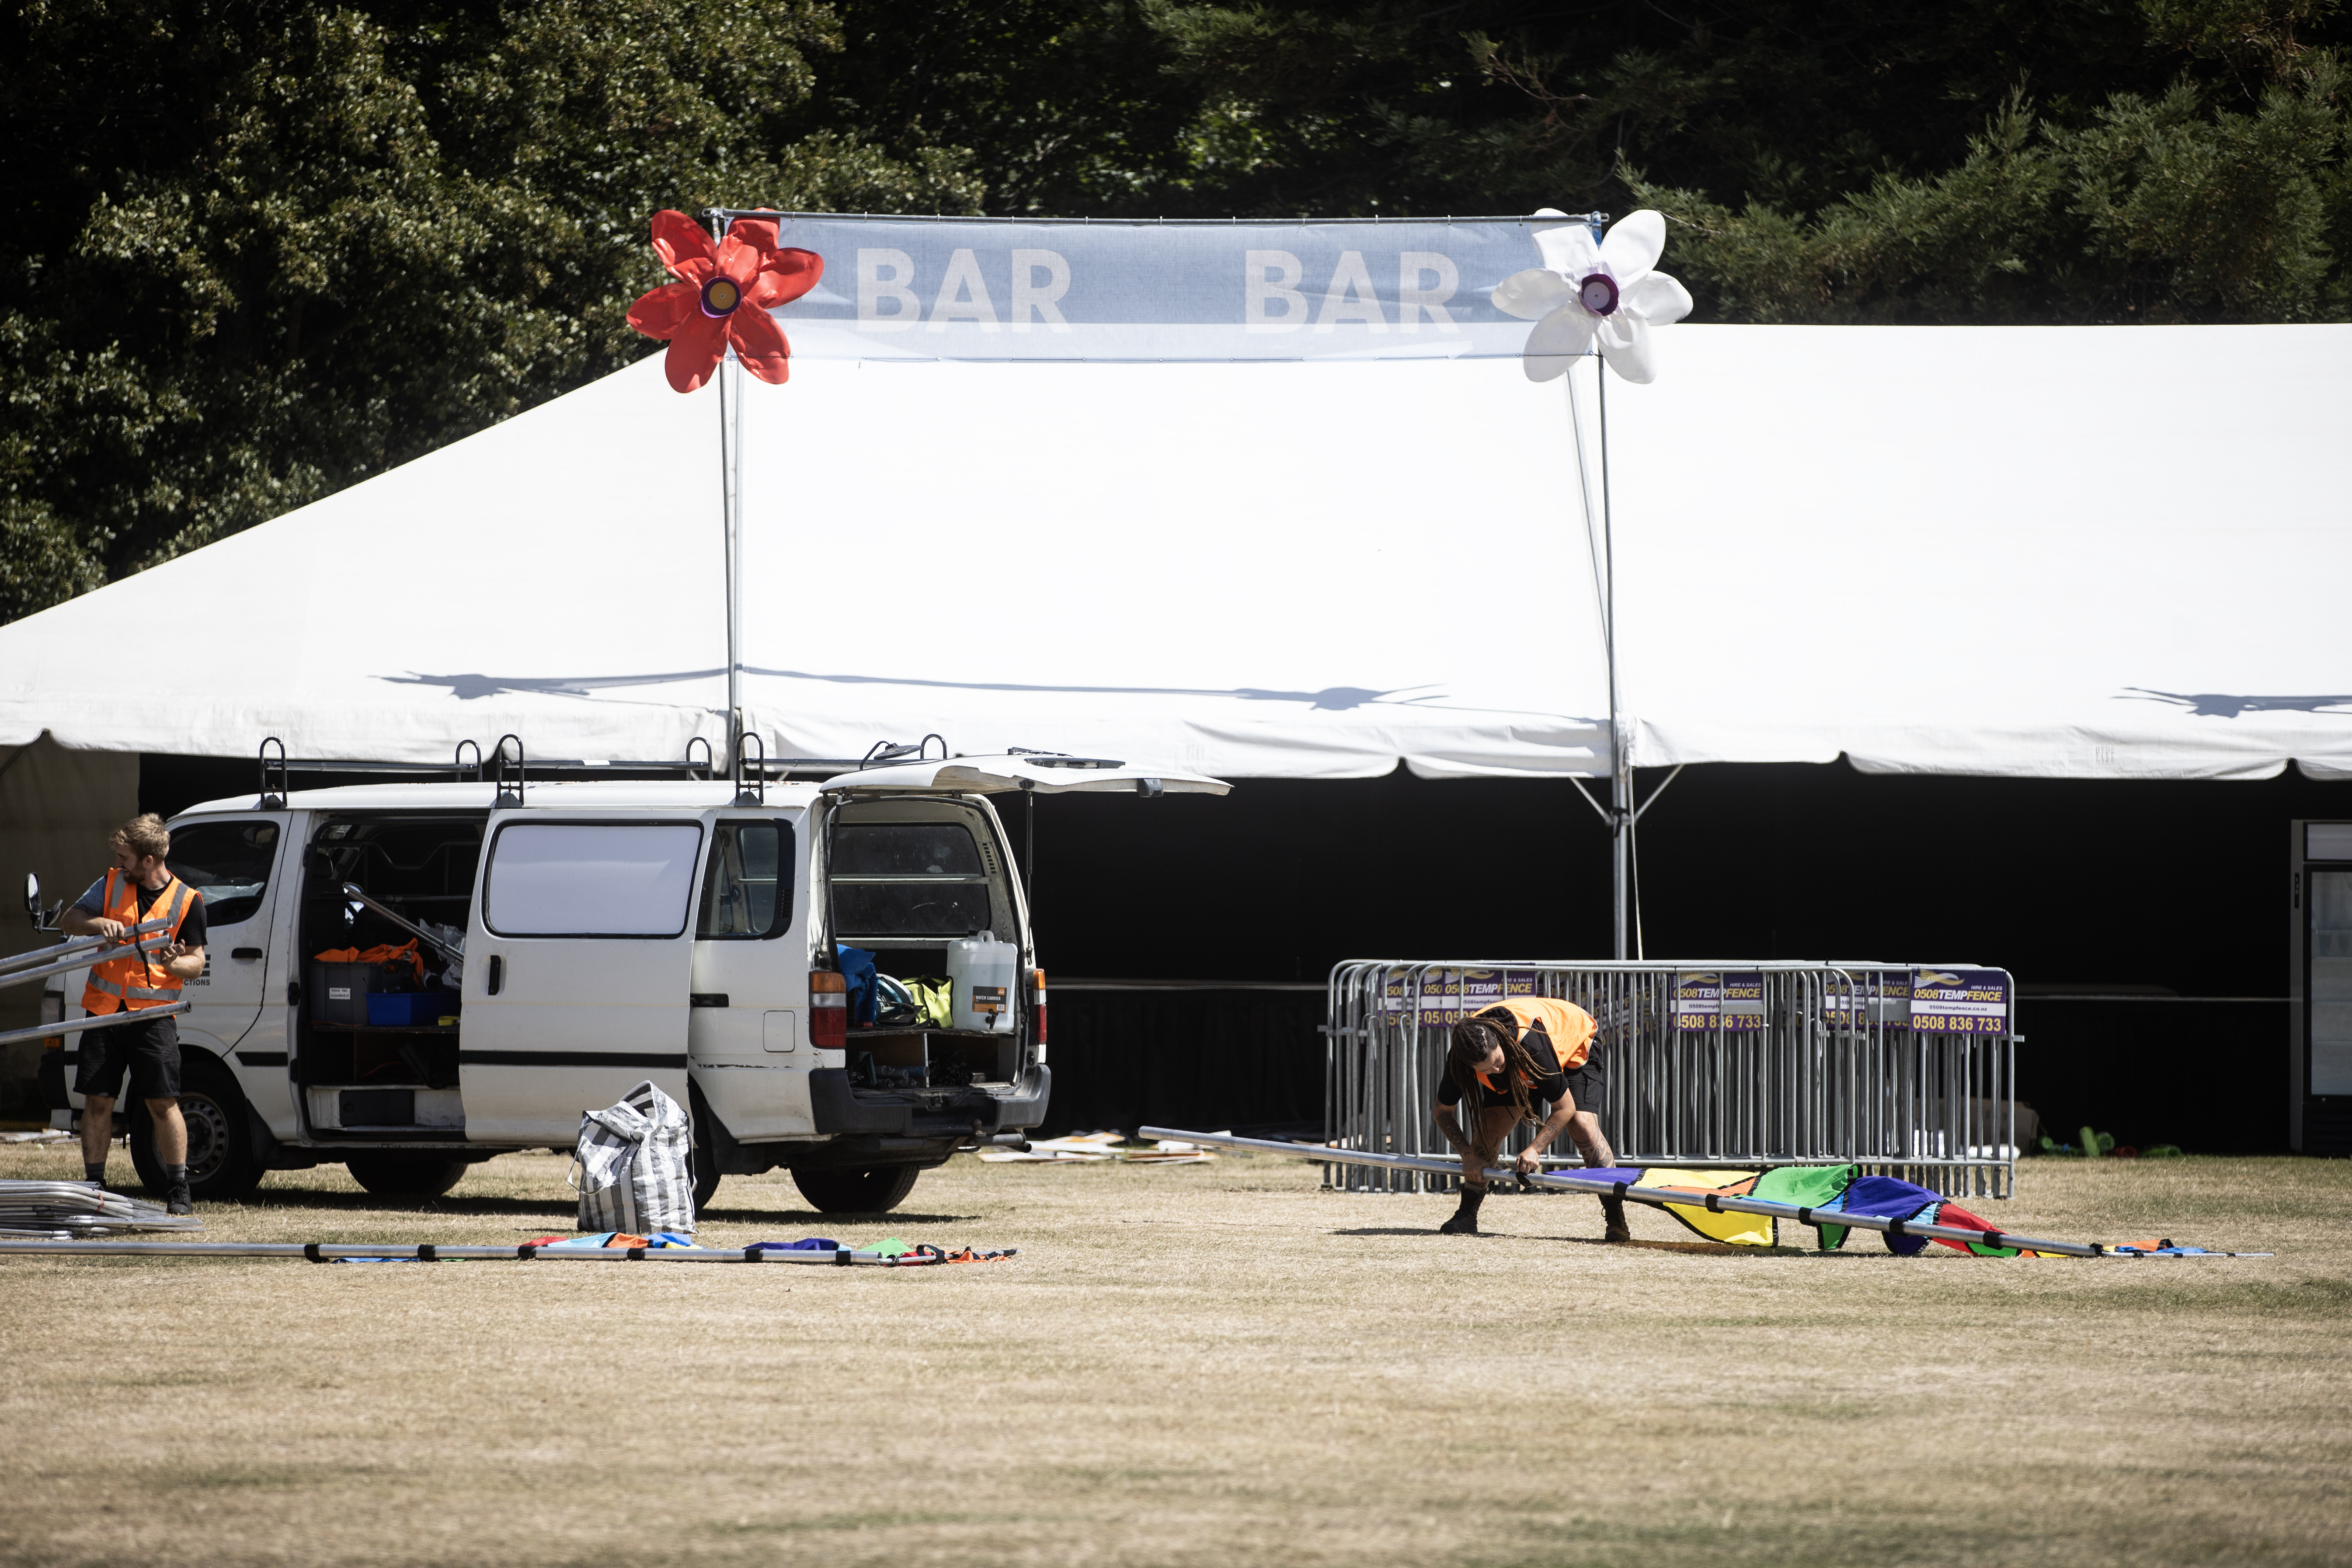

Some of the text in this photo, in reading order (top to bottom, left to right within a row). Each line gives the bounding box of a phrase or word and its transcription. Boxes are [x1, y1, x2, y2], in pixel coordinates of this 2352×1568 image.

[857, 248, 1461, 334] BAR BAR
[1914, 988, 2002, 1001] 0508TEMPFENCE
[1737, 1015, 1761, 1028] 733
[1913, 1015, 2001, 1032] 0508 836 733
